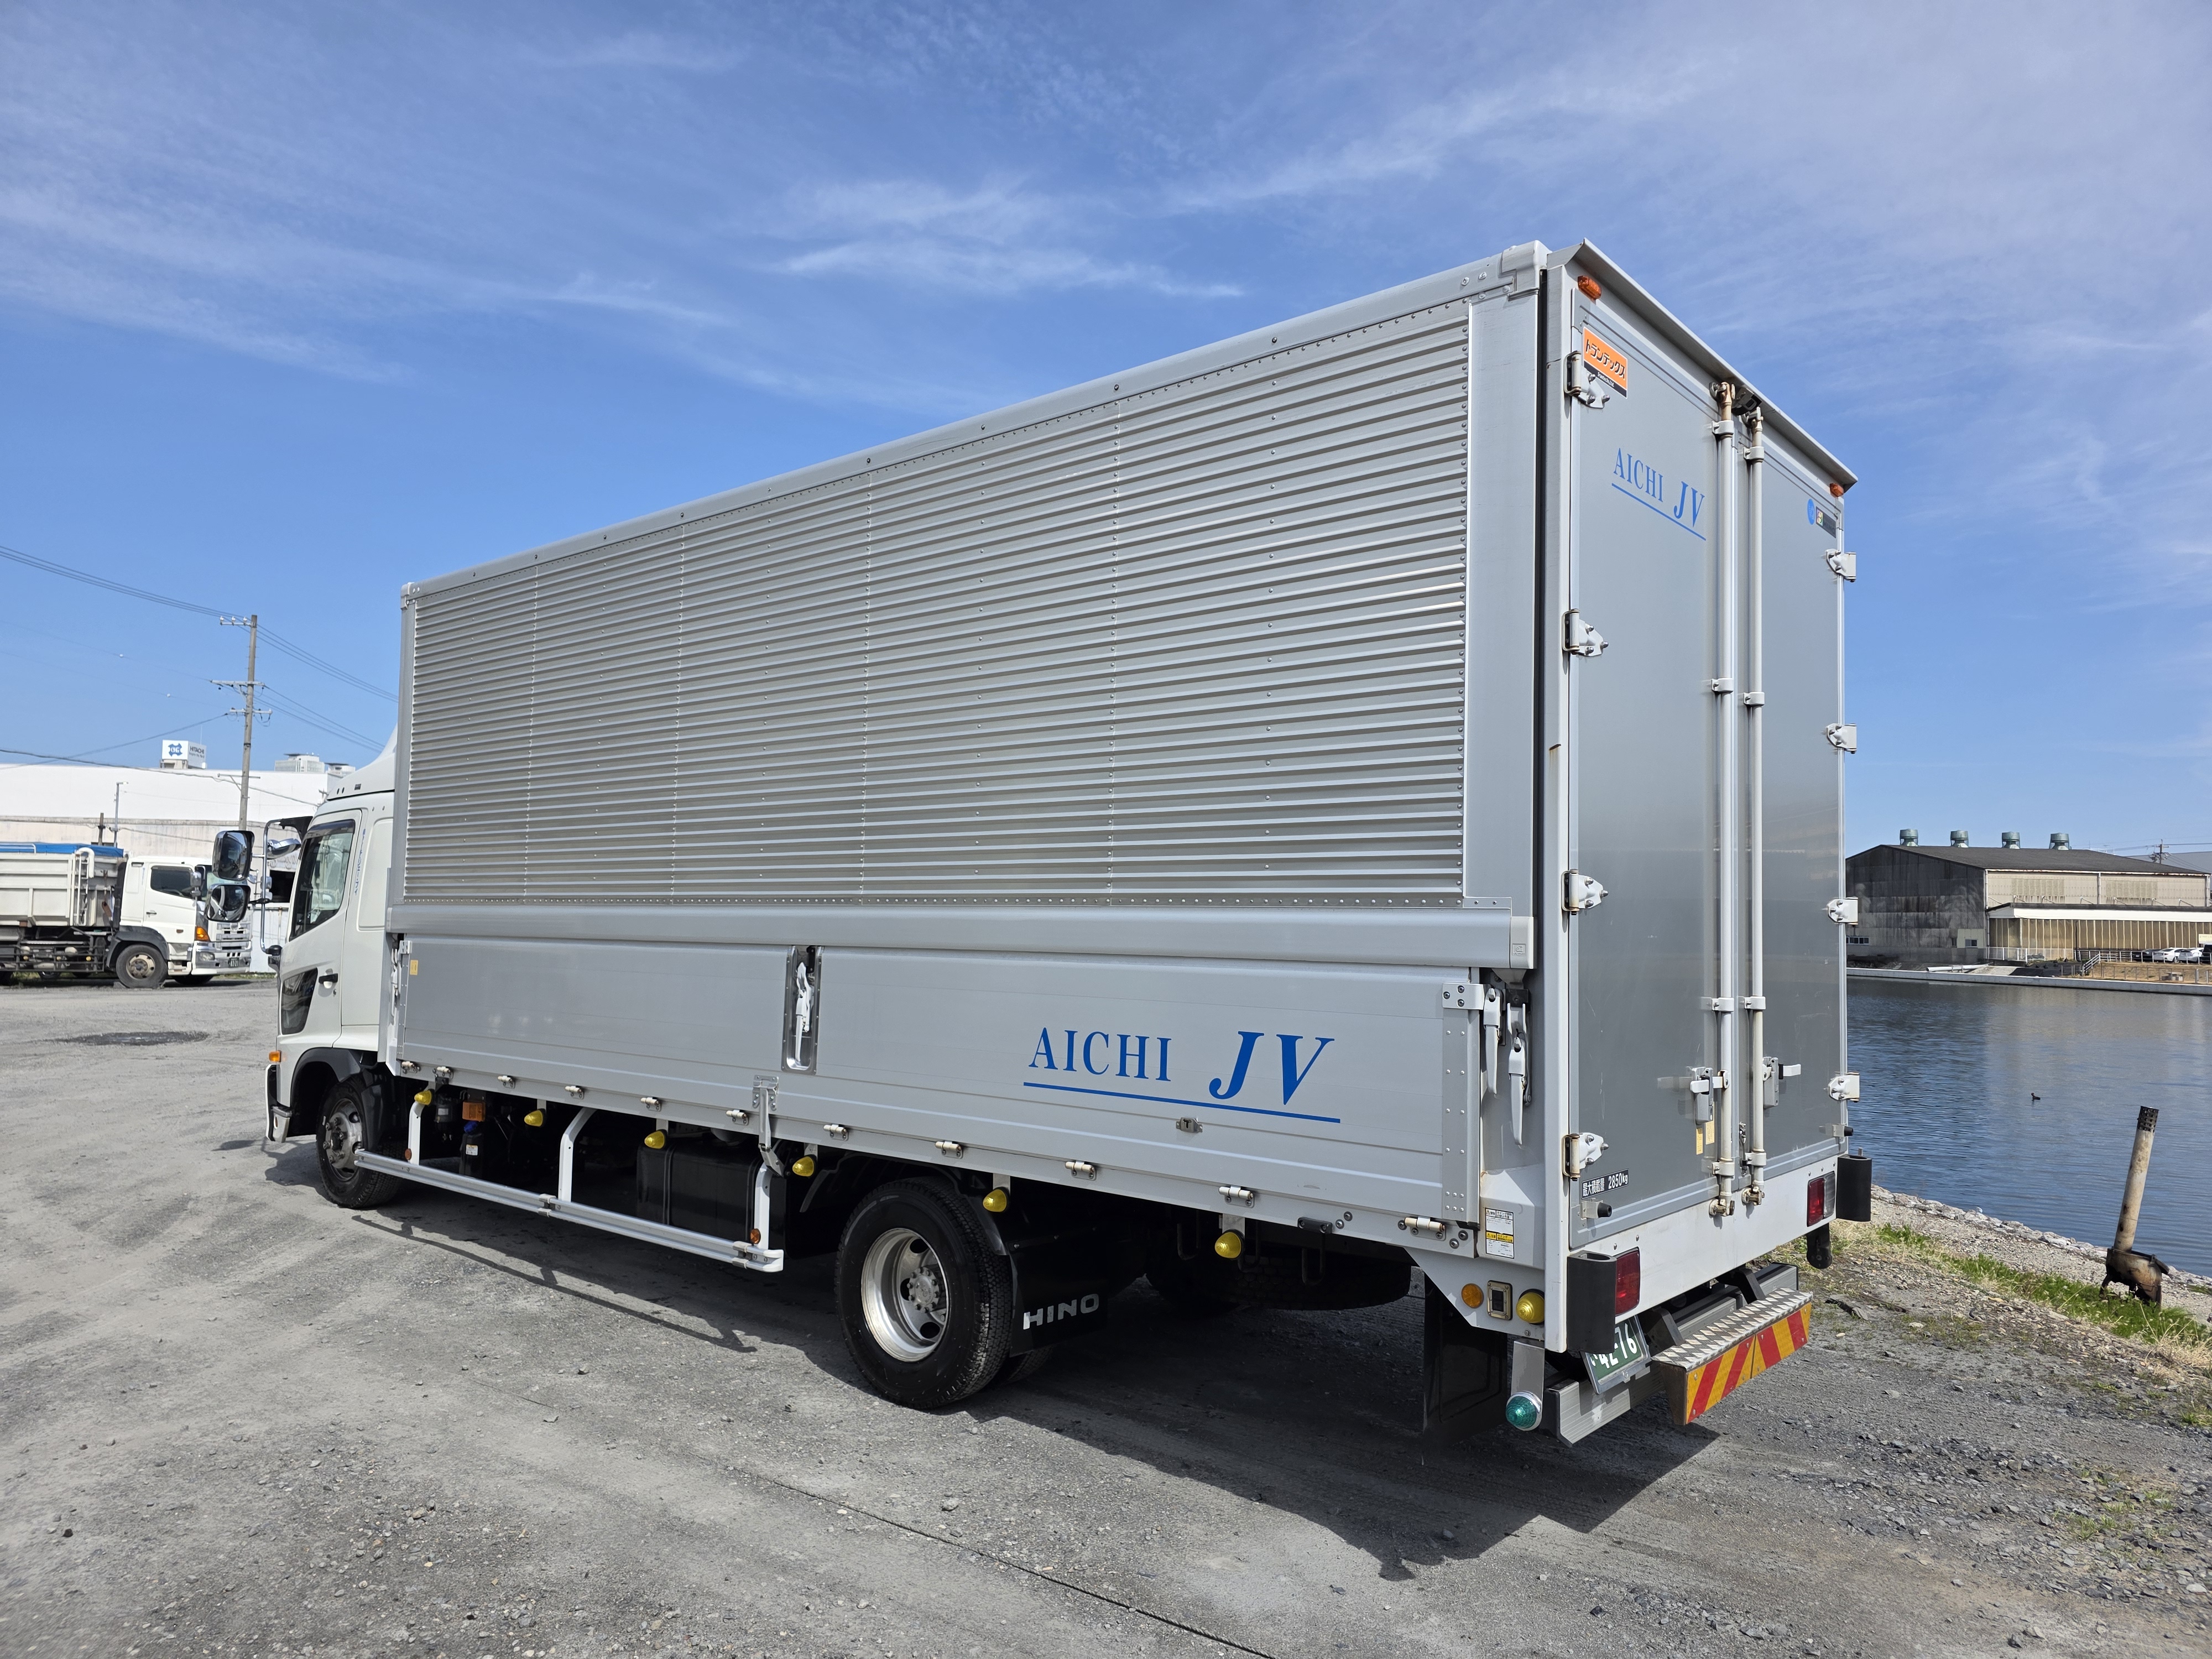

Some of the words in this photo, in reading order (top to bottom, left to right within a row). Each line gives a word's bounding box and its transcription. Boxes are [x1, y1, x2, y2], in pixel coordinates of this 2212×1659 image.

[1585, 338, 1626, 380] トランテックス
[1613, 447, 1663, 503] AICHI
[1673, 481, 1705, 528] JV
[190, 745, 205, 755] HITACHI
[1028, 1027, 1172, 1082] AICHI
[1209, 1031, 1335, 1105] JV
[1583, 1177, 1605, 1196] 最大積載量
[1608, 1172, 1628, 1190] 2850kg
[1023, 1293, 1099, 1330] HINO
